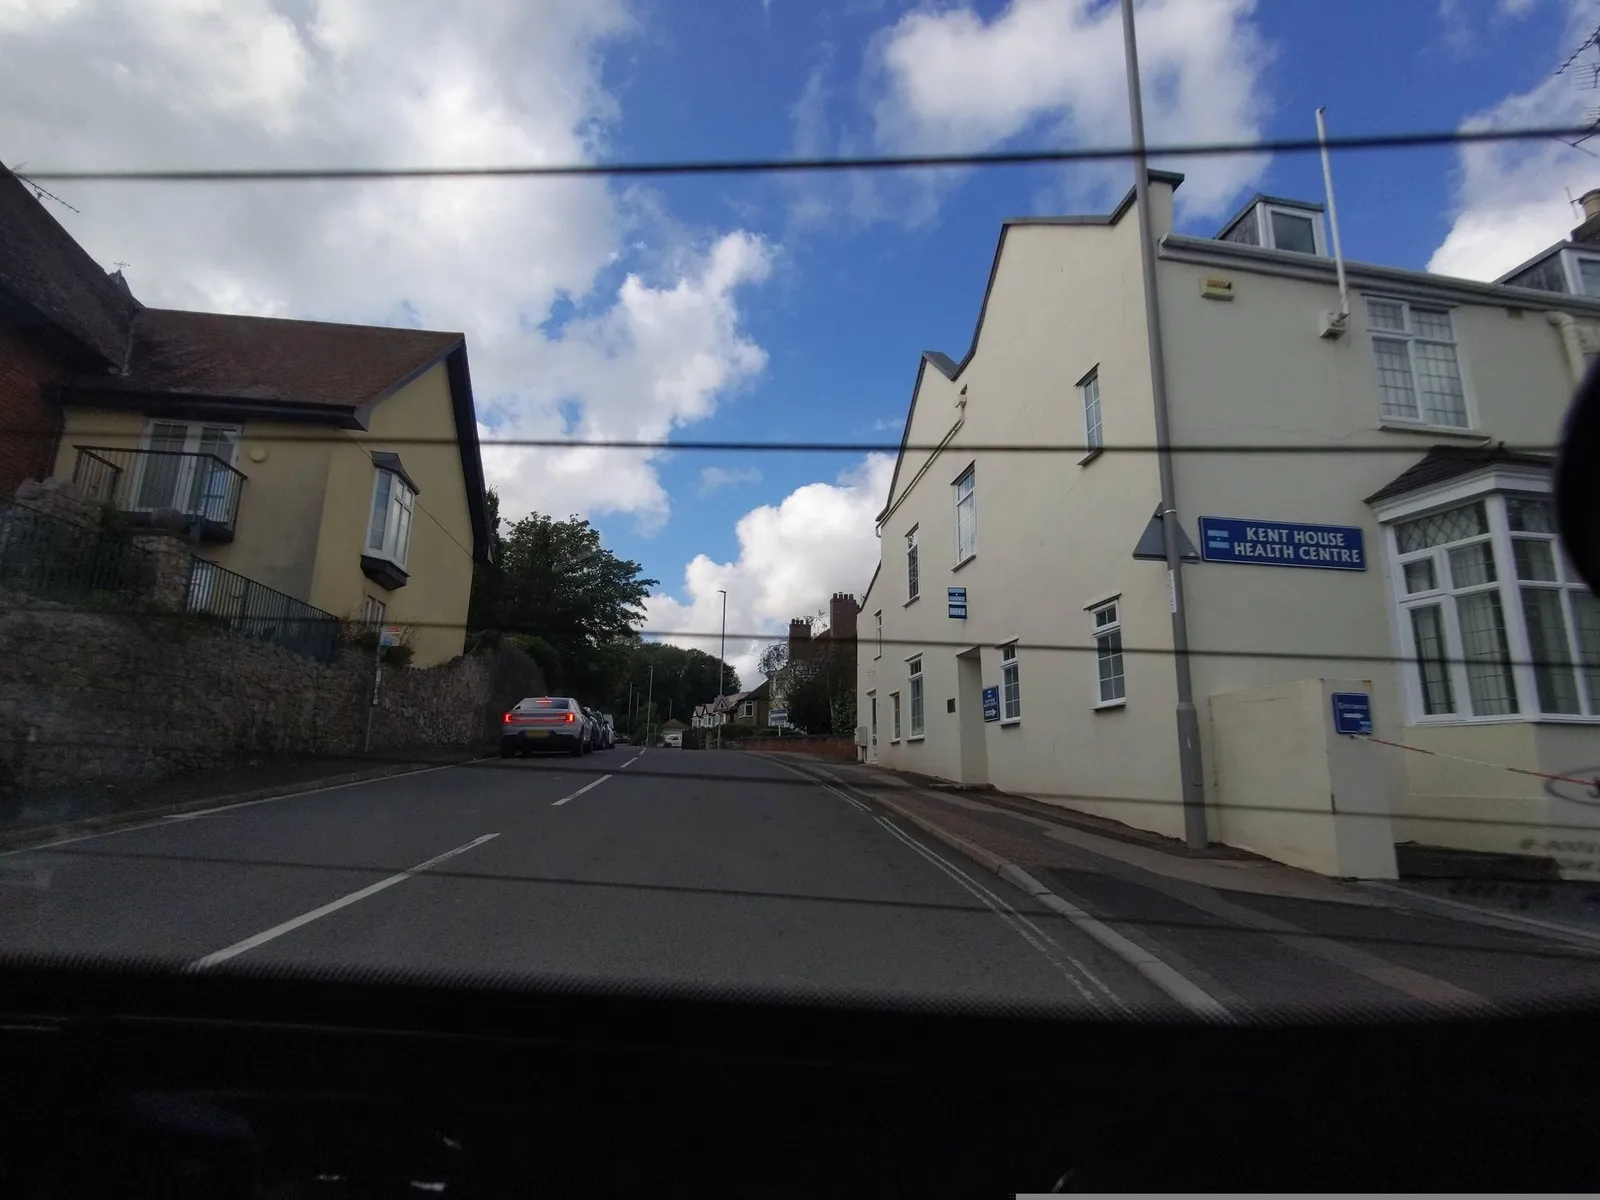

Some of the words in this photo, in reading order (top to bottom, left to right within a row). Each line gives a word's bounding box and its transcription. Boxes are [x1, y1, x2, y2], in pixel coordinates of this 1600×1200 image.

[1246, 527, 1289, 543] KENT
[1294, 530, 1345, 546] HOUSE
[1234, 542, 1294, 559] HEALTH
[1299, 546, 1361, 563] CENTRE
